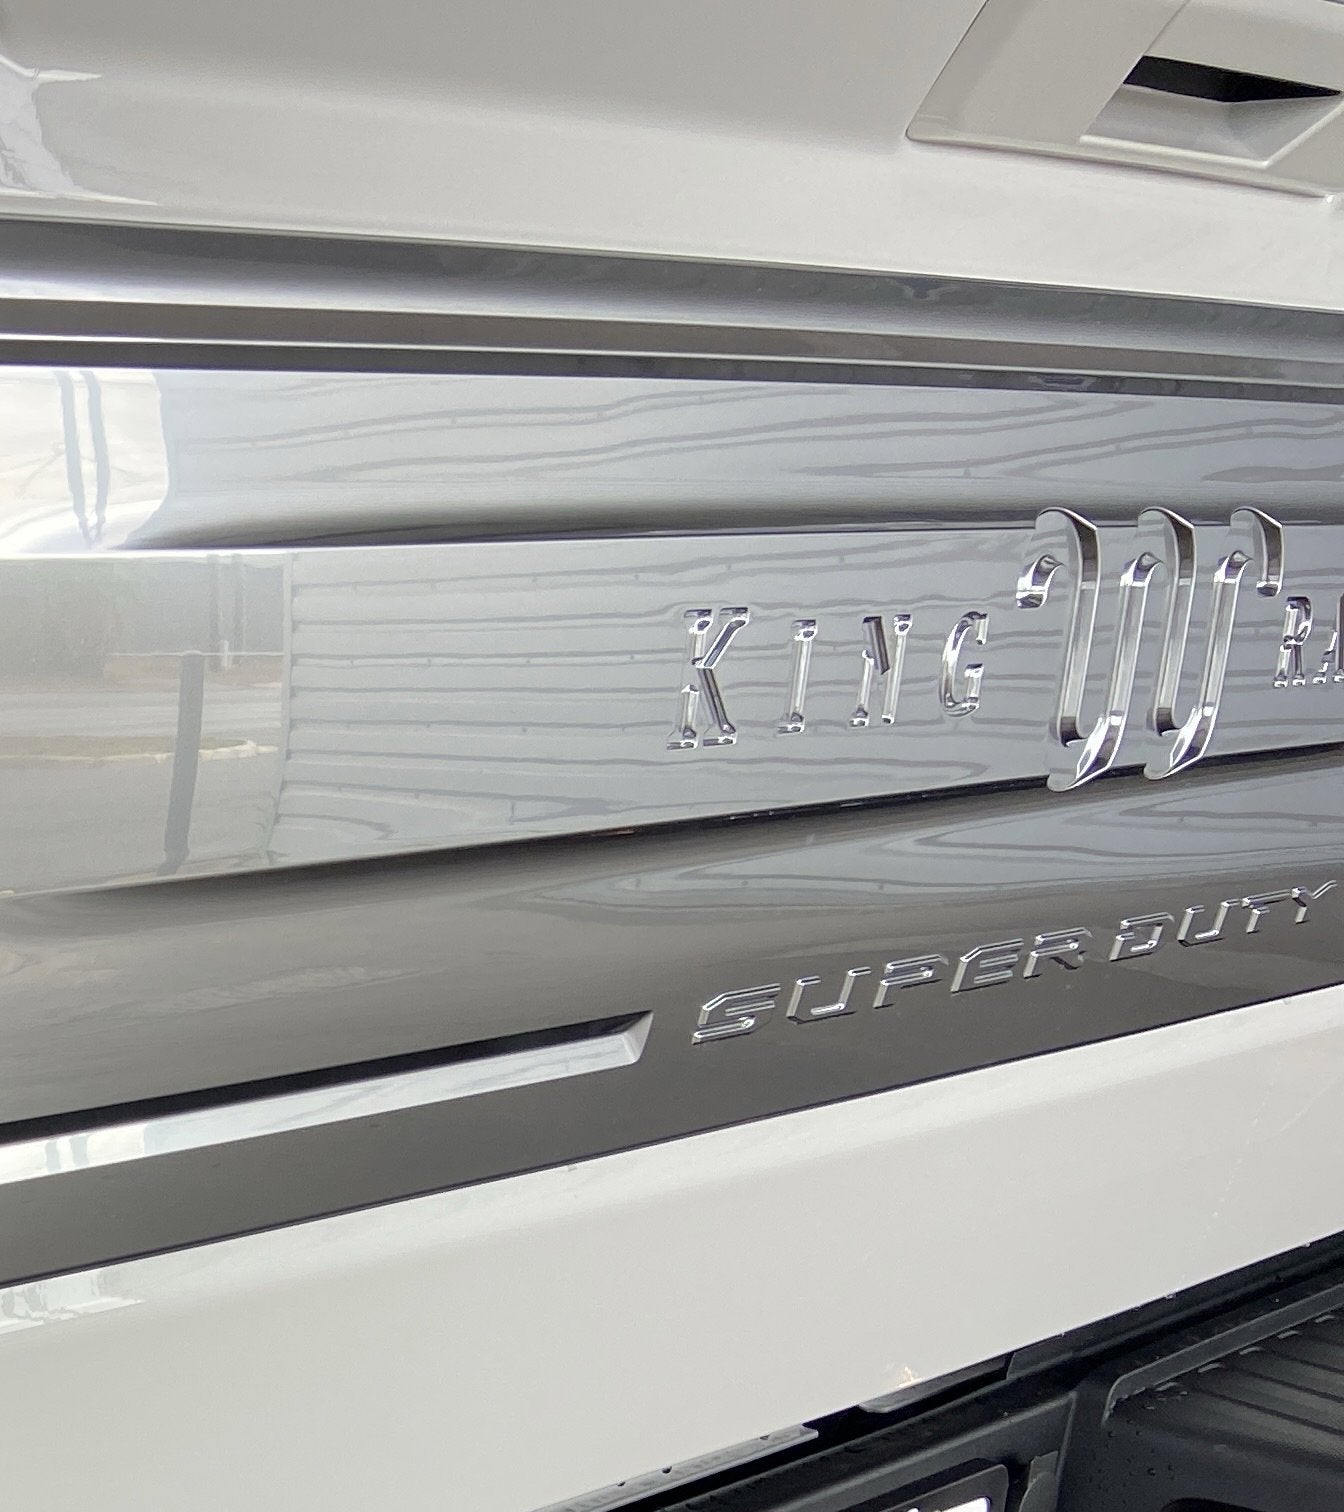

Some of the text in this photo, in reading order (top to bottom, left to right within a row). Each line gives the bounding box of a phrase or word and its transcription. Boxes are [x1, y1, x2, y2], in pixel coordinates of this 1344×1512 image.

[666, 605, 990, 750] KING
[691, 879, 1338, 1046] SUPER DUTY
